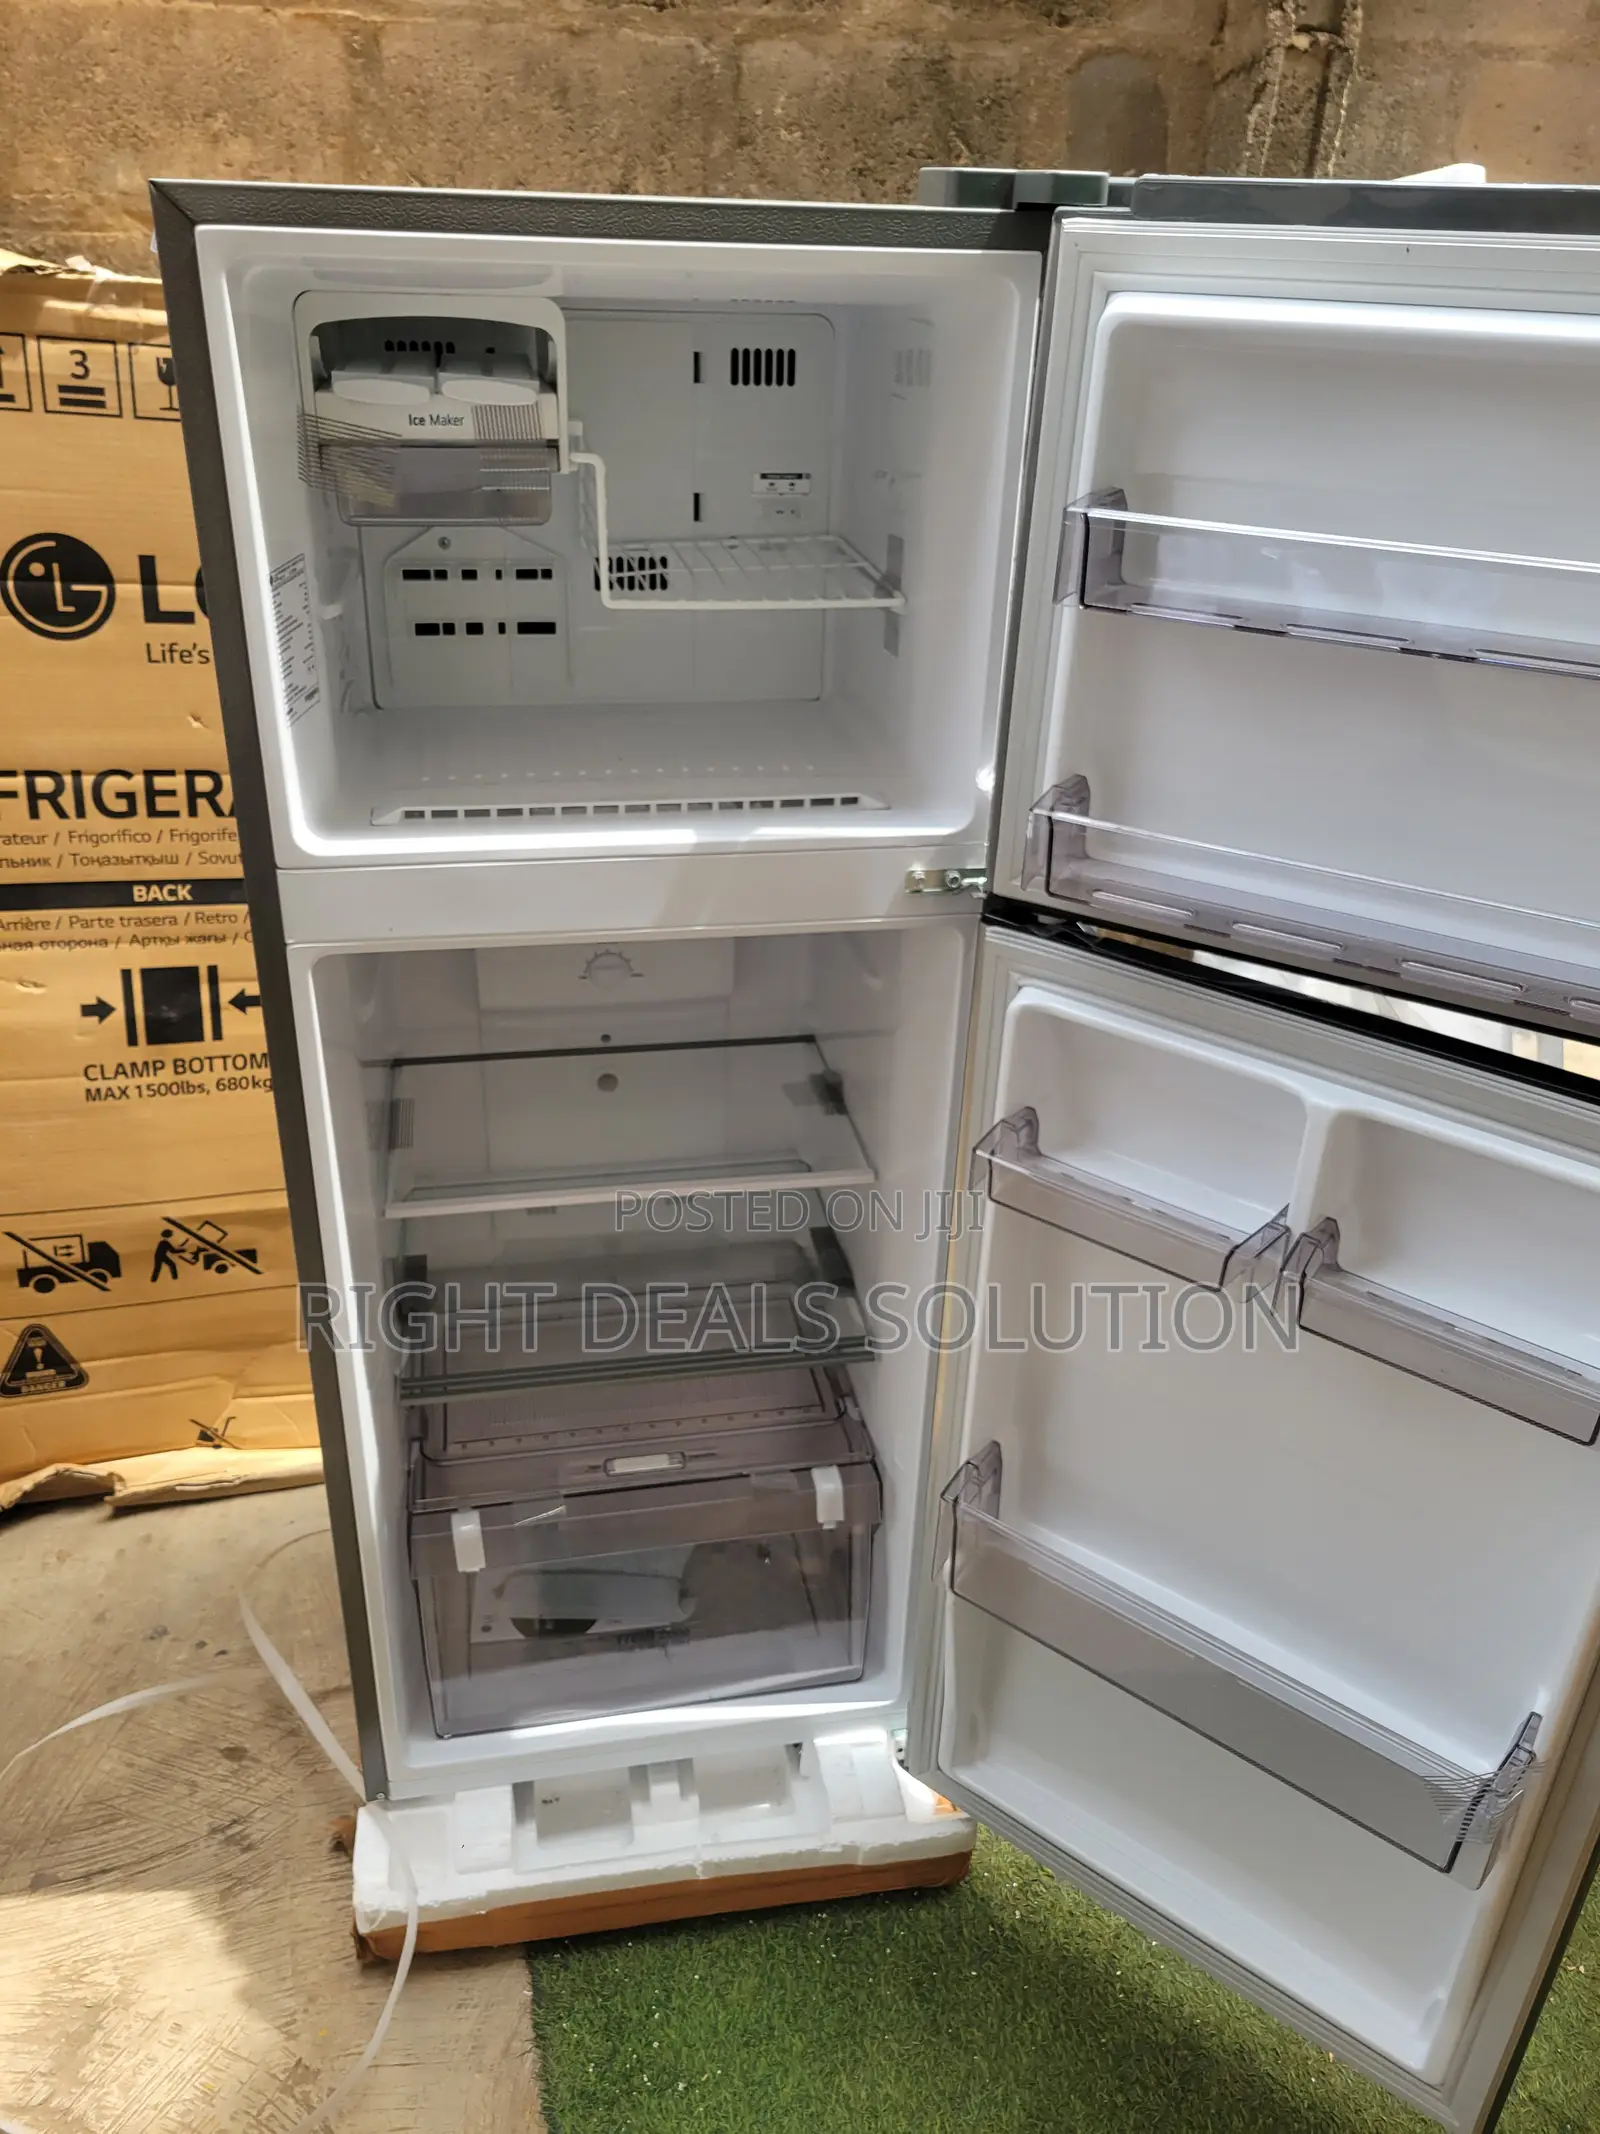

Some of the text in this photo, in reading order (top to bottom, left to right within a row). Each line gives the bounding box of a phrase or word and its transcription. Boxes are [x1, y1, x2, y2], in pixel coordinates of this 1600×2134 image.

[69, 350, 90, 380] 3
[408, 414, 464, 426] Ice Maker
[138, 554, 209, 625] L
[0, 769, 237, 819] FRIGER
[132, 884, 193, 902] BACK
[69, 915, 115, 929] Parte
[120, 915, 178, 927] trasera
[195, 911, 238, 925] Retro
[83, 1053, 269, 1082] CLAMP BOTTOM
[84, 1084, 130, 1102] MAX
[135, 1079, 210, 1098] 1500lbs,
